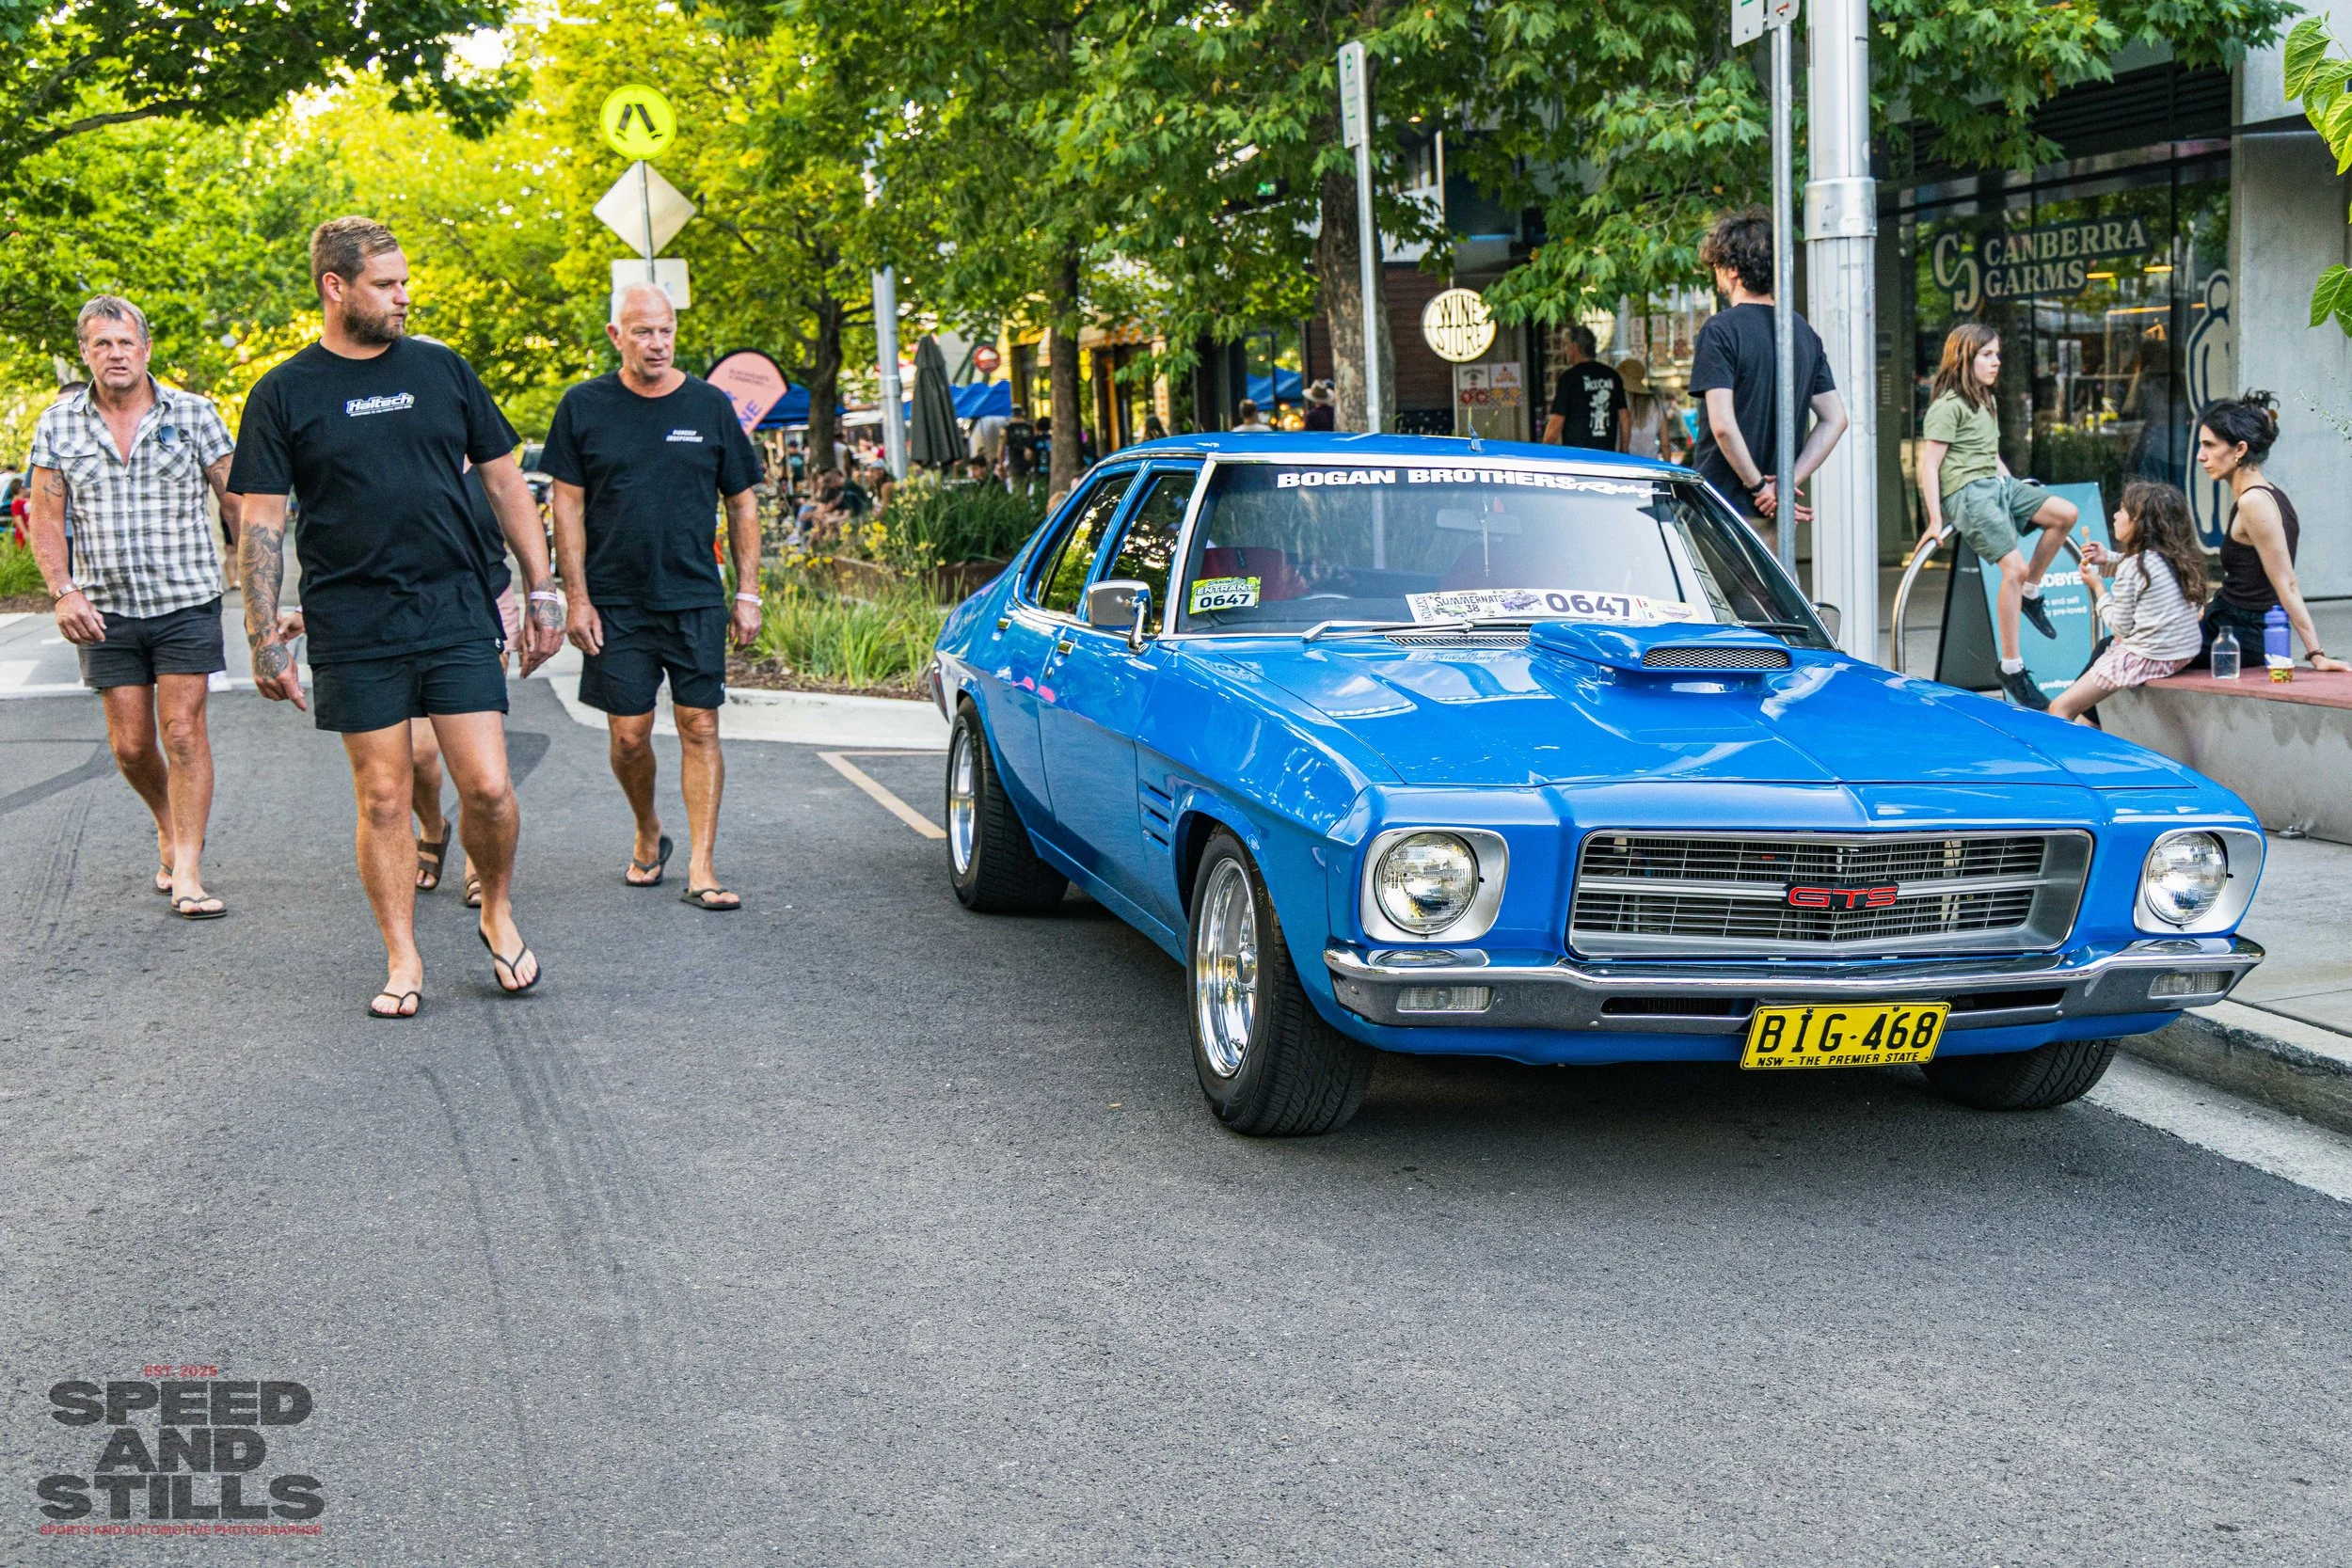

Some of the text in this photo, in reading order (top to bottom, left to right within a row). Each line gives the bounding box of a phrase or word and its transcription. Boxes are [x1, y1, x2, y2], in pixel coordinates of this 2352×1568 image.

[1984, 218, 2147, 266] CANBERRA
[1984, 260, 2088, 298] GARMS
[1438, 294, 1481, 327] WINE
[1437, 323, 1483, 356] STORE
[347, 393, 414, 414] Haltech
[1277, 469, 1396, 489] BOGAN
[1407, 468, 1577, 490] BROTHERS
[1197, 584, 1254, 595] ENTRANT
[1434, 594, 1506, 607] SUMMERNATS
[1200, 594, 1250, 609] 0647
[1467, 604, 1481, 613] 38
[1546, 593, 1630, 617] 0647
[1788, 886, 1899, 909] GTS
[1756, 1056, 1785, 1067] NSW
[1799, 1055, 1821, 1066] THE
[1828, 1053, 1881, 1065] PREMIER
[1884, 1052, 1919, 1063] STATE
